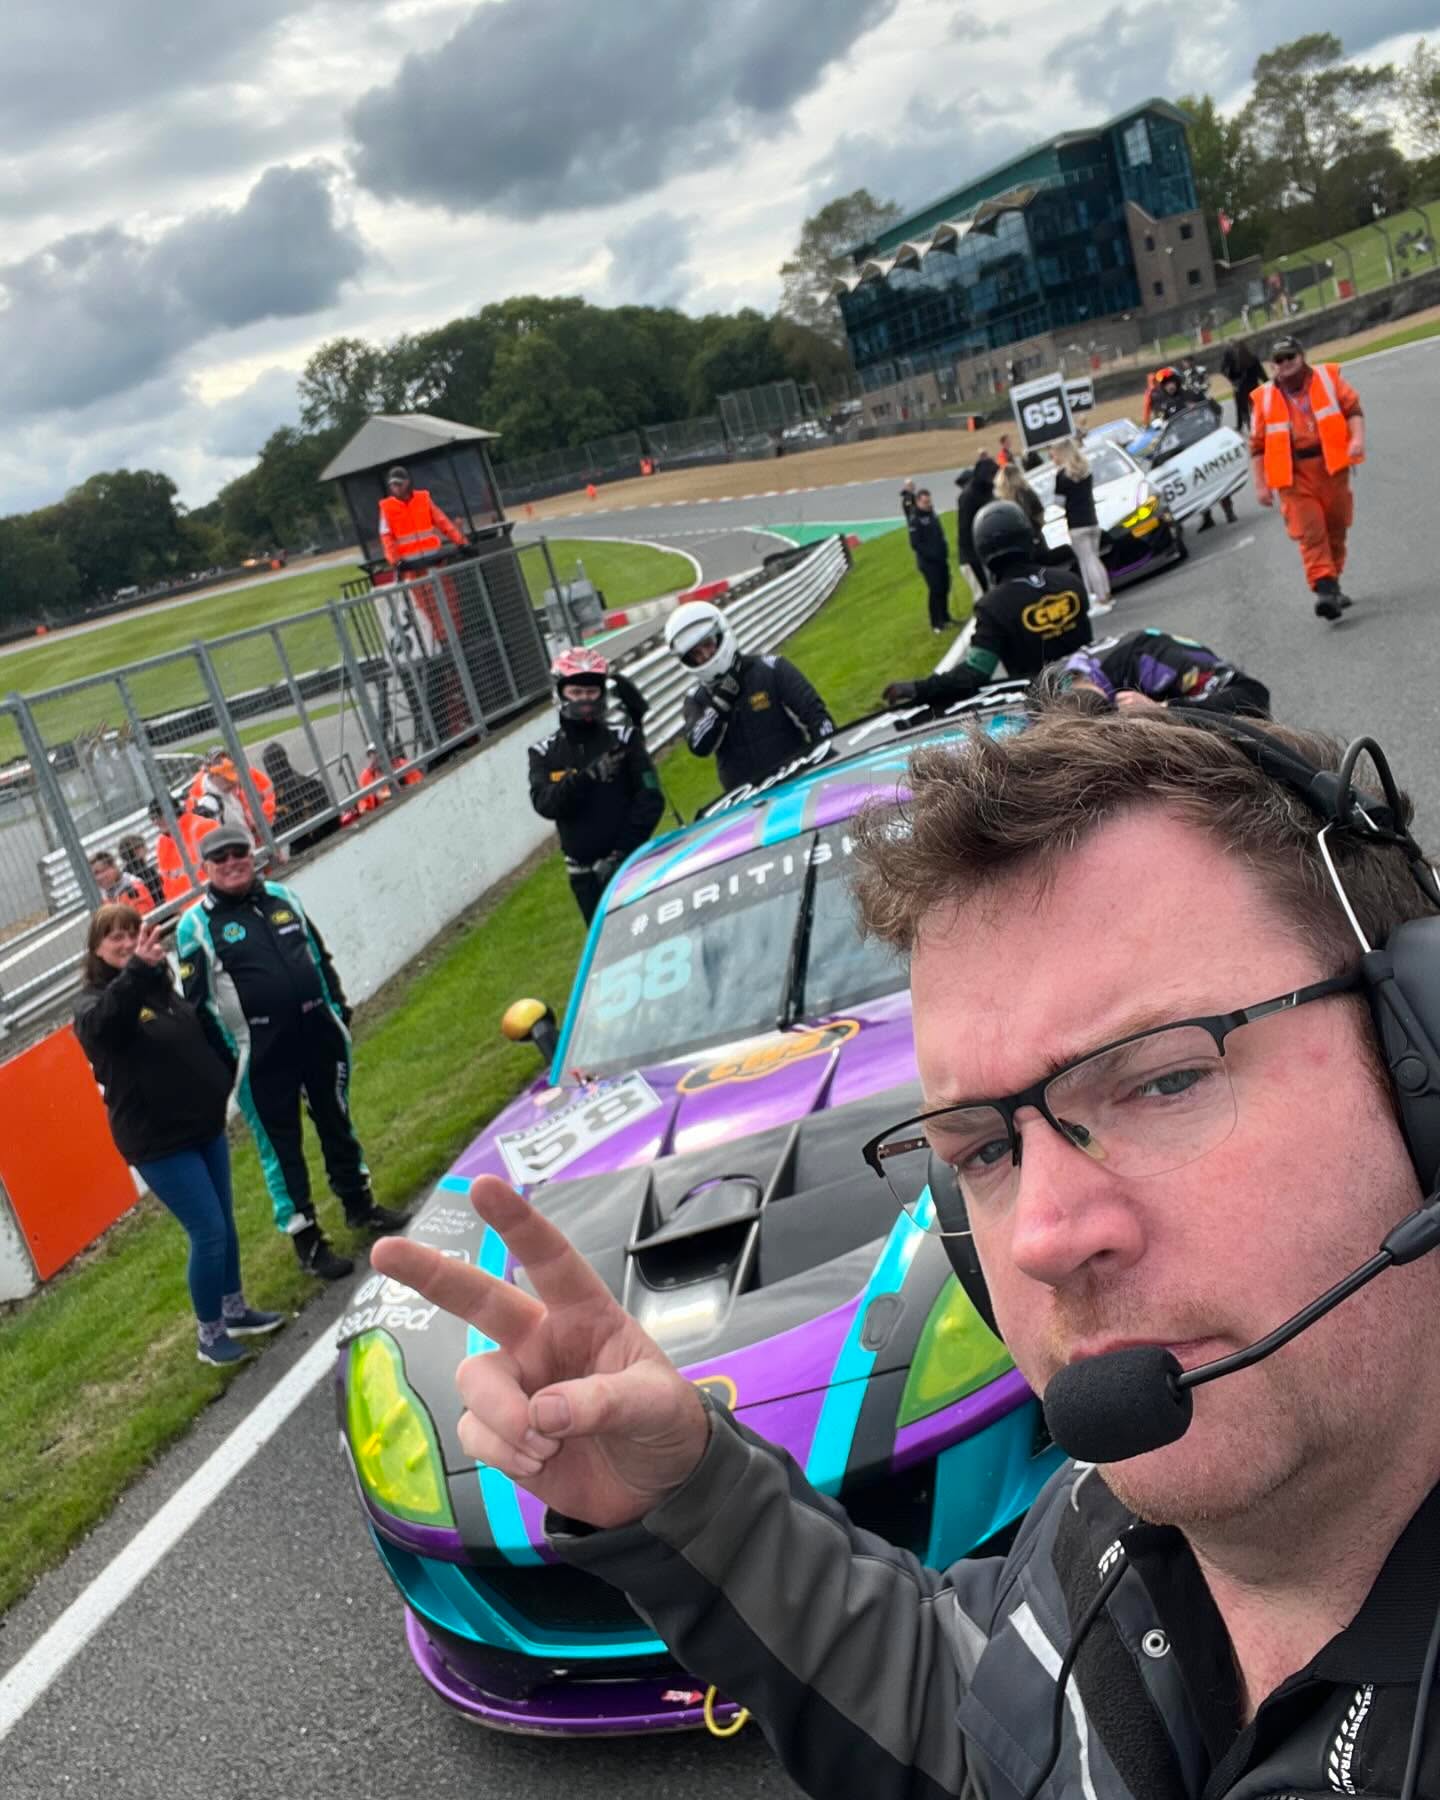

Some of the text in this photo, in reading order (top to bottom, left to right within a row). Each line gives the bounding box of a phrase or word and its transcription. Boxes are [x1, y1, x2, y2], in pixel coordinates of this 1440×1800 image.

[1022, 396, 1063, 430] 65
[1162, 477, 1186, 502] 65
[597, 935, 692, 1021] 58
[518, 1089, 644, 1171] 58
